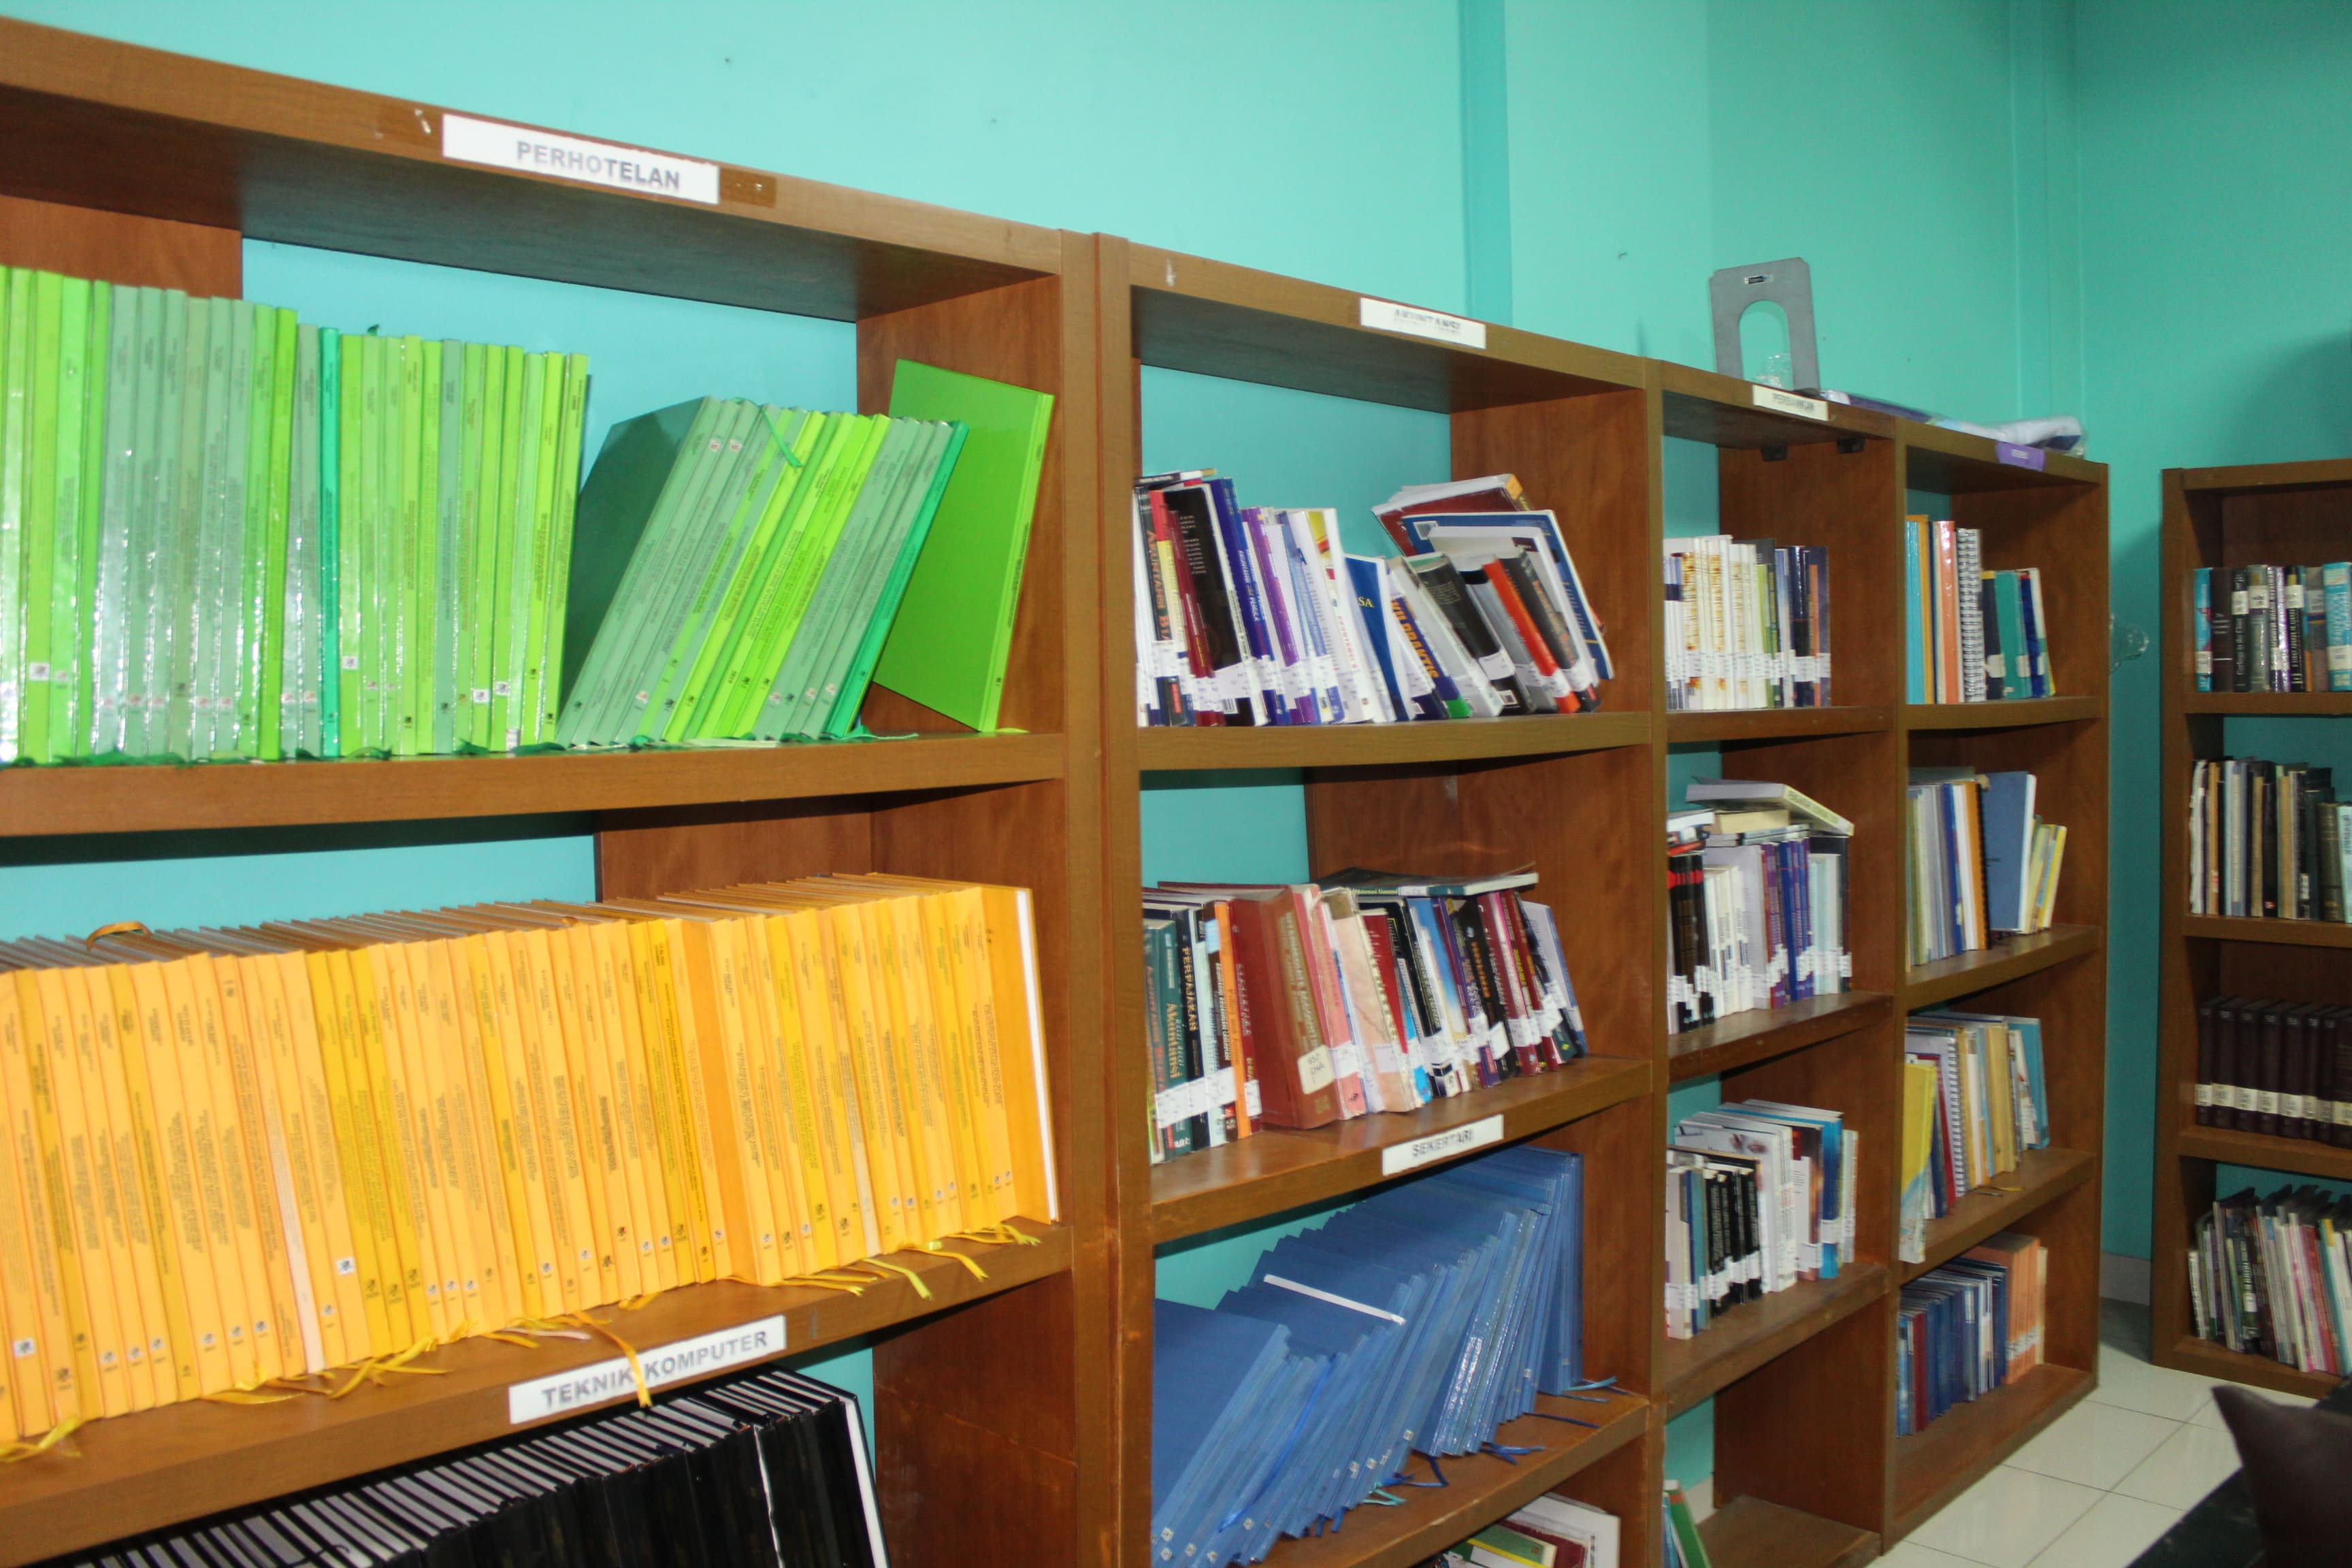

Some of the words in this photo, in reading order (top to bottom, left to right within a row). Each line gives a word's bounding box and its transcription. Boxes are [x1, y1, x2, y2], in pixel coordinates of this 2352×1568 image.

[517, 140, 680, 191] PERHOTELAN
[1145, 529, 1165, 609] AKUNTANSI
[1181, 946, 1198, 1032] PERPAJAKAN
[1165, 1002, 1182, 1079] Akuntansi
[542, 1366, 635, 1409] TEKNIK
[643, 1330, 768, 1382] KOMPUTER
